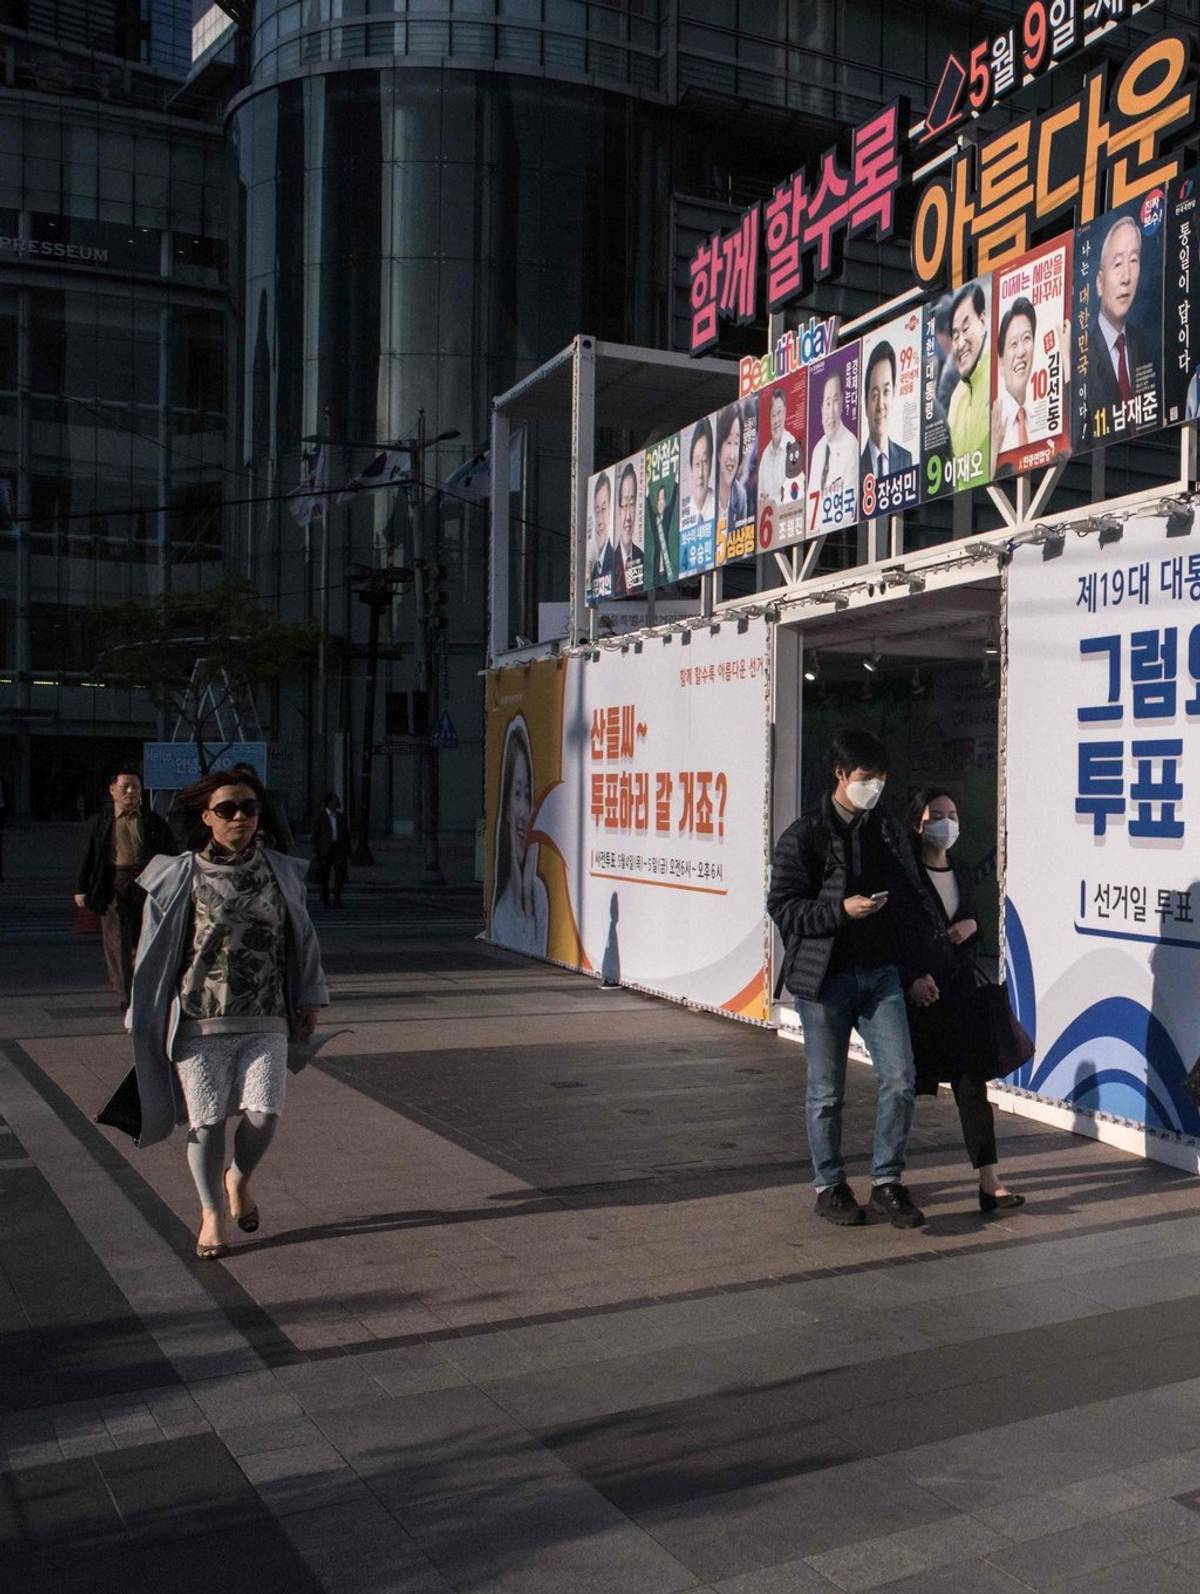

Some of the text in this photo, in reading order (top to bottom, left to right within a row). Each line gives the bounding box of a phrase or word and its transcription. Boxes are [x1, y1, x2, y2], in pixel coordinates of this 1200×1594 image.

[968, 29, 1013, 107] 5월
[914, 37, 1191, 287] 아름다운
[690, 107, 898, 348] 함께 할수록
[1002, 253, 1062, 300] 이제는 세상을
[1032, 275, 1063, 306] 바꾸자
[1178, 221, 1190, 374] 통일이 답이다
[1031, 368, 1047, 402] 10
[1047, 353, 1061, 431] 김선동
[1093, 407, 1109, 438] 11
[1112, 390, 1158, 431] 남재준
[652, 437, 679, 483] 안철수
[927, 454, 942, 495] 9
[944, 451, 983, 488] 이재오
[809, 490, 820, 531] 7
[822, 488, 857, 525] 오영국
[862, 473, 877, 516] 8
[877, 470, 917, 509] 장성민
[716, 518, 728, 566] 5
[727, 524, 755, 559] 심상정
[759, 506, 773, 548] 6
[689, 538, 712, 566] 유승민
[1076, 563, 1150, 613] 제19대
[591, 704, 647, 760] 산들씨~
[591, 770, 728, 837] 투표하러 갈 거죠?
[1075, 739, 1185, 838] 투표
[1094, 882, 1148, 923] 선거일
[1154, 889, 1194, 924] 투표
